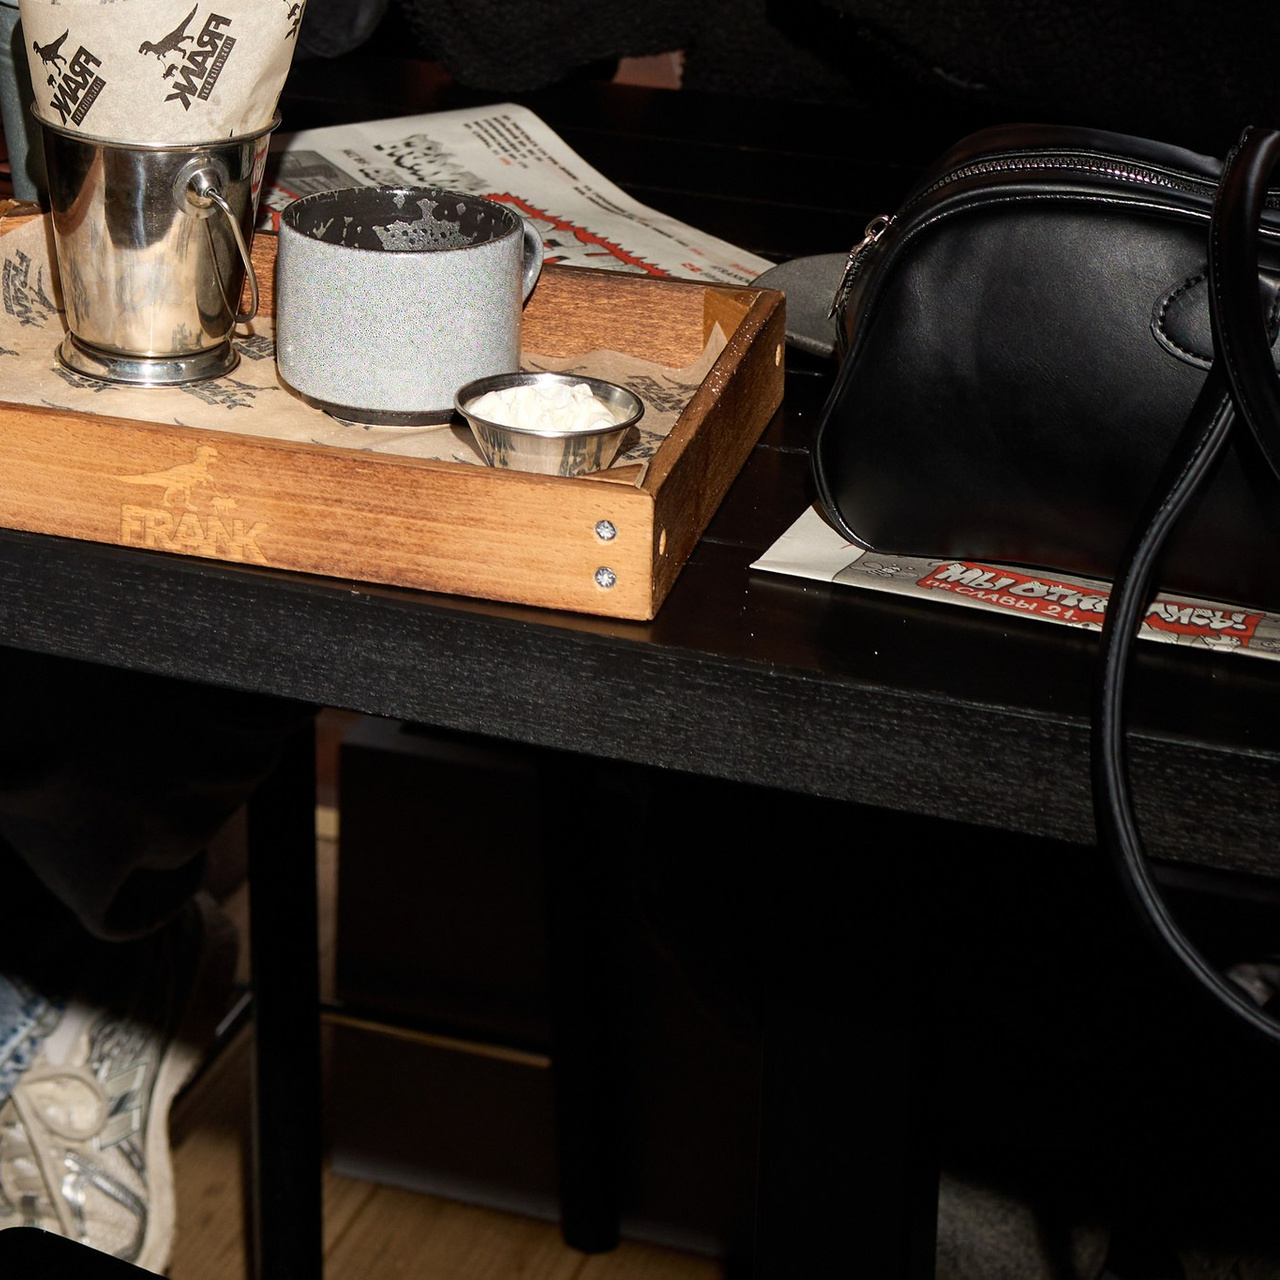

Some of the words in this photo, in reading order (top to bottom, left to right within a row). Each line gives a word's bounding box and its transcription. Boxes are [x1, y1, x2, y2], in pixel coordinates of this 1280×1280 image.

[120, 503, 270, 563] FRANK
[934, 563, 1016, 591] МЫ
[954, 586, 1038, 611] СЛАВЫ
